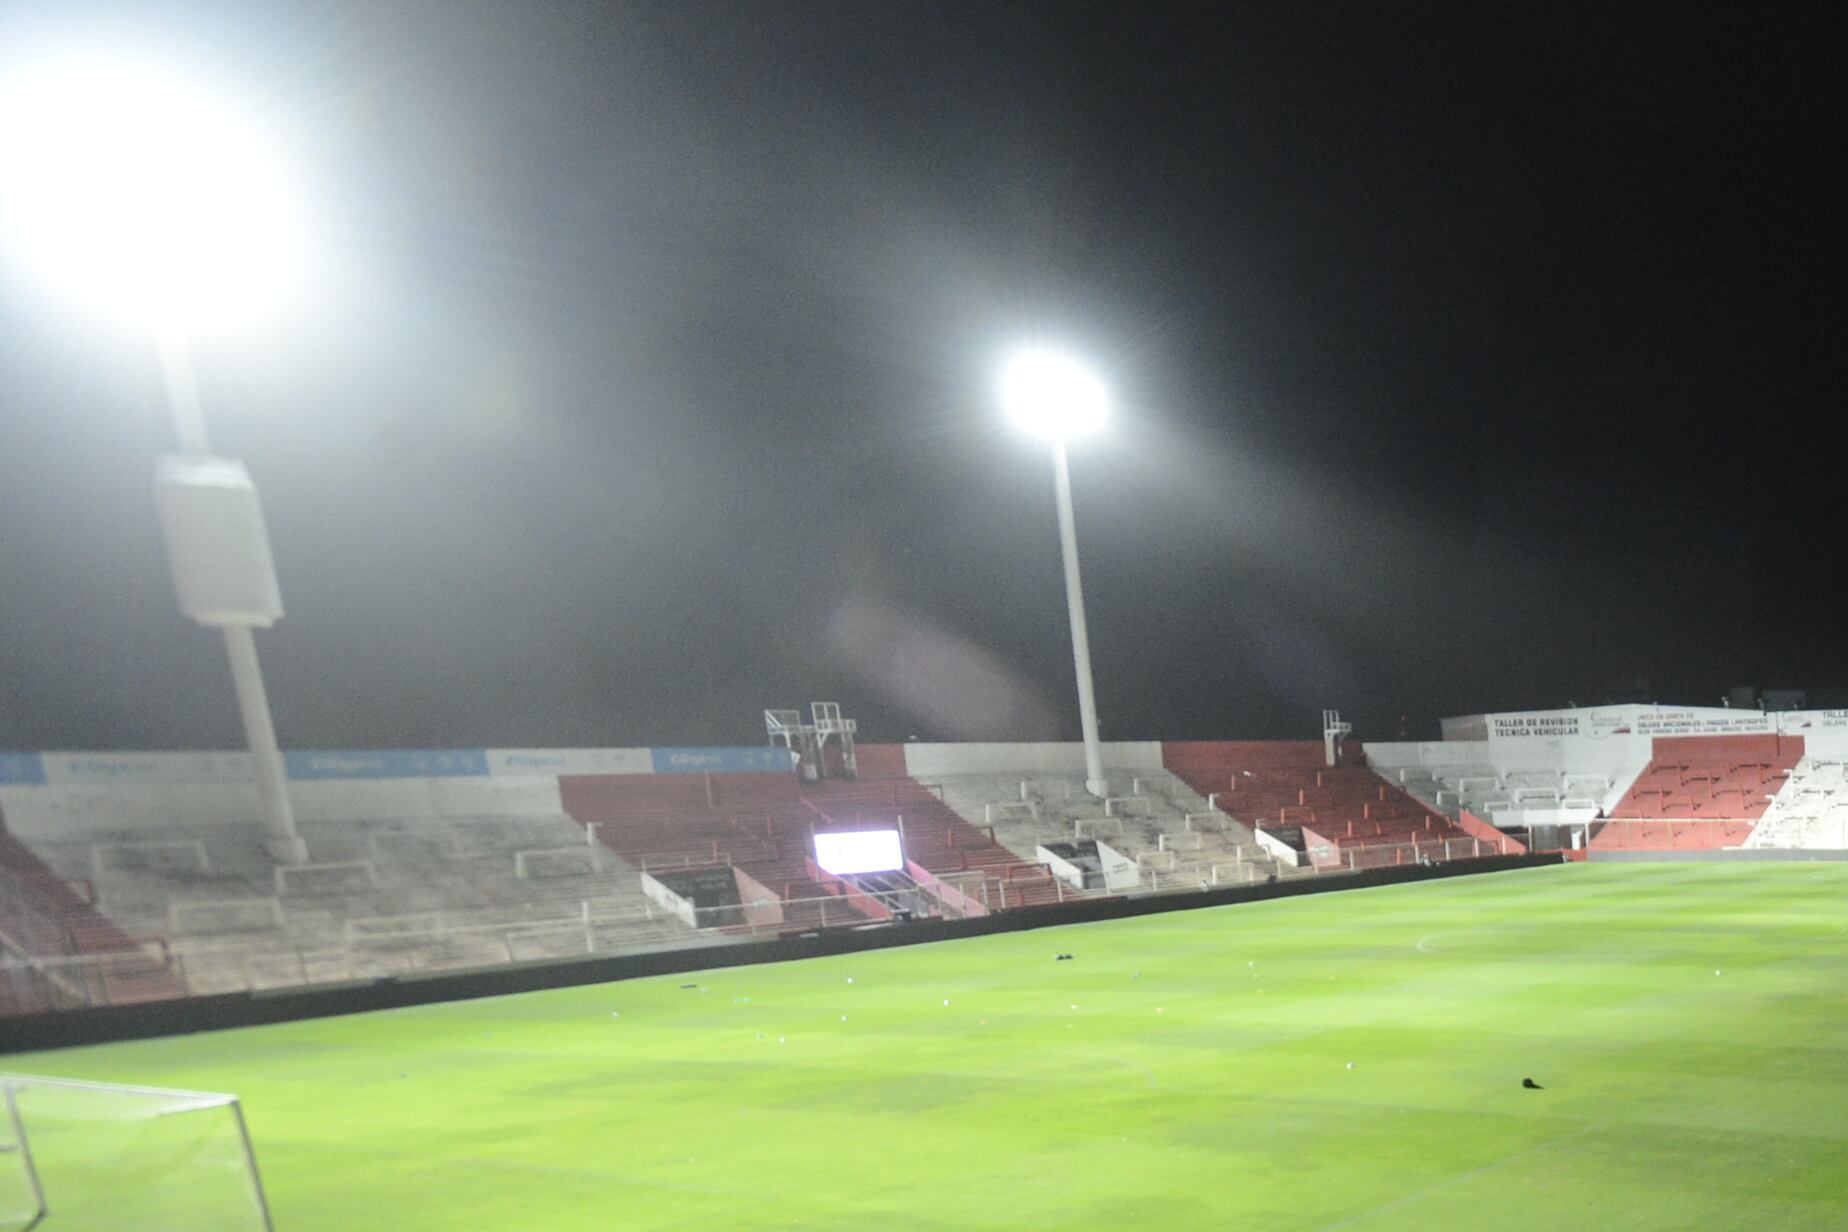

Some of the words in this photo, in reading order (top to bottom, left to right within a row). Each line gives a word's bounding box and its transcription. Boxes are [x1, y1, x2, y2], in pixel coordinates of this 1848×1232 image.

[1494, 718, 1524, 727] TALLER
[1526, 718, 1537, 727] DE
[1539, 718, 1579, 727] REVISION
[1495, 728, 1531, 737] TECNICA
[1533, 727, 1580, 737] VEHICULAR
